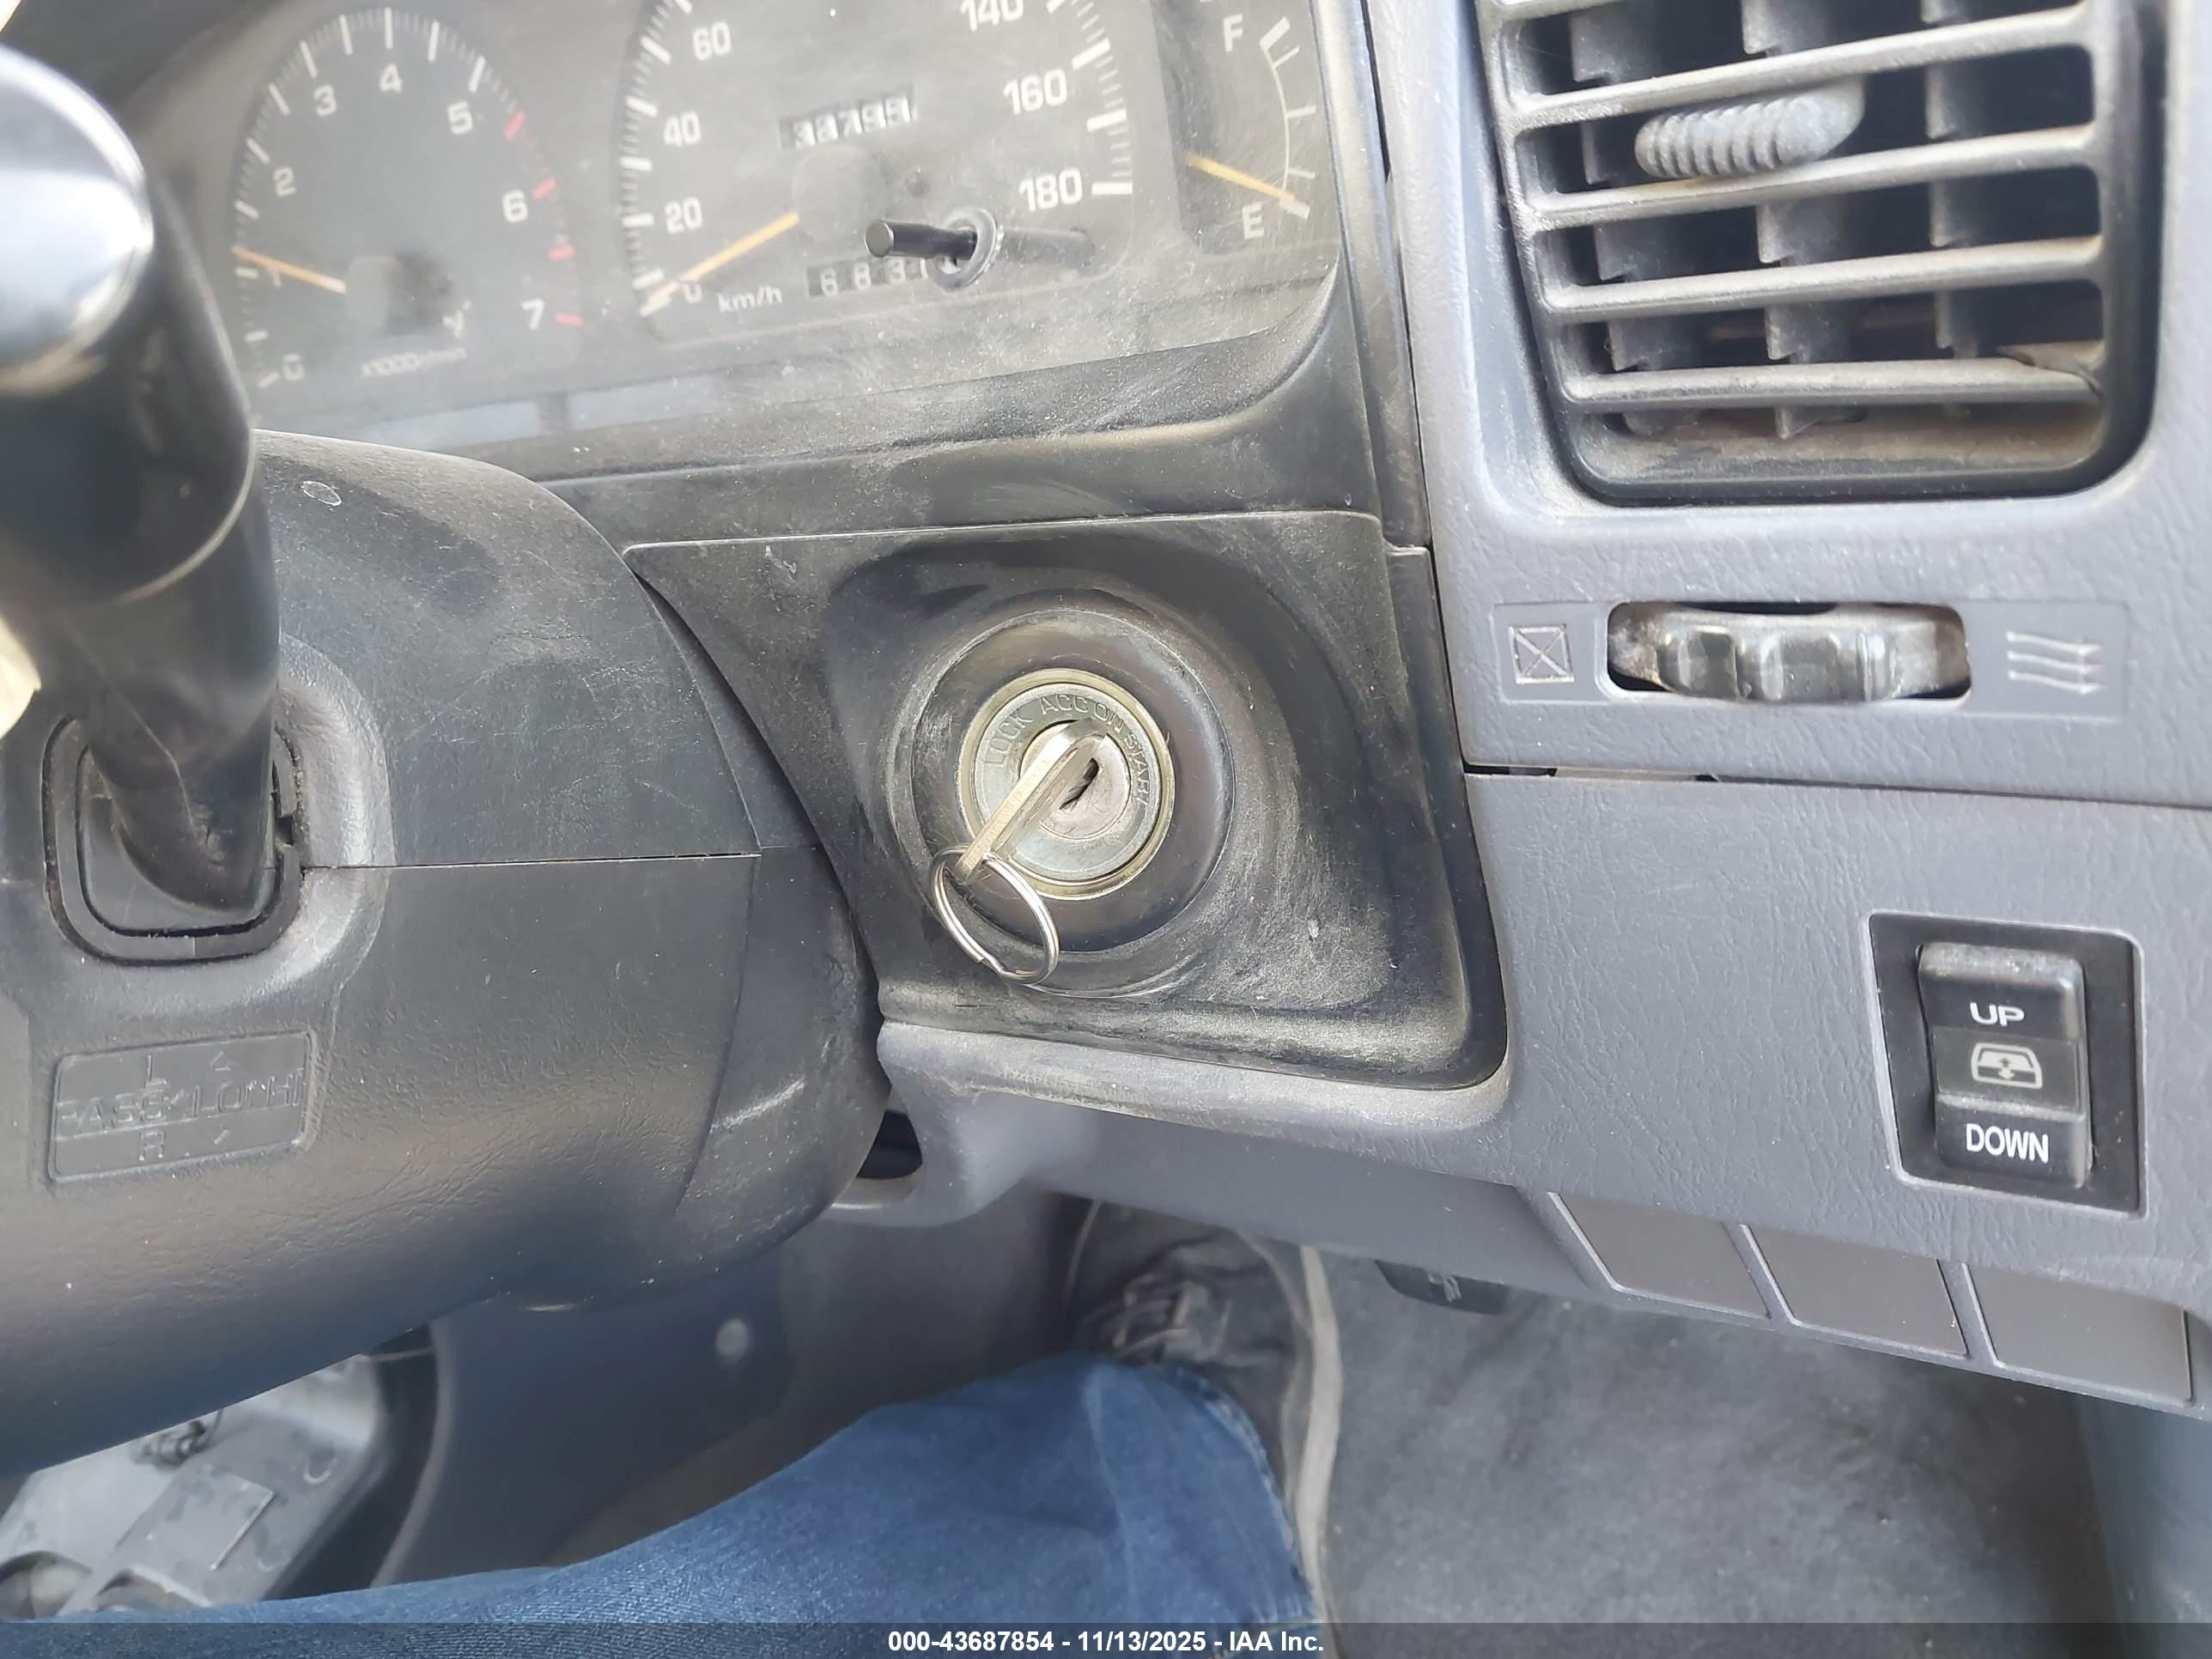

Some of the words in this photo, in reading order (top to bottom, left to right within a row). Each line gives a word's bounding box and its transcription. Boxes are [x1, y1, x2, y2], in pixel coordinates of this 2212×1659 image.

[692, 21, 732, 61] 60
[1223, 14, 1243, 52] F
[380, 64, 403, 92] 4
[1002, 69, 1067, 115] 160
[313, 86, 337, 117] 3
[447, 101, 473, 134] 5
[663, 111, 702, 148] 40
[273, 167, 296, 197] 2
[1018, 167, 1083, 212] 180
[502, 191, 528, 223] 6
[665, 196, 703, 234] 20
[1242, 201, 1264, 240] E
[521, 299, 544, 330] 7
[717, 284, 782, 314] km/h
[985, 709, 1033, 769] LOCK
[1040, 693, 1089, 714] ACC
[1094, 702, 1125, 734] ON
[1970, 1002, 2025, 1027] UP
[1966, 1123, 2050, 1164] DOWN
